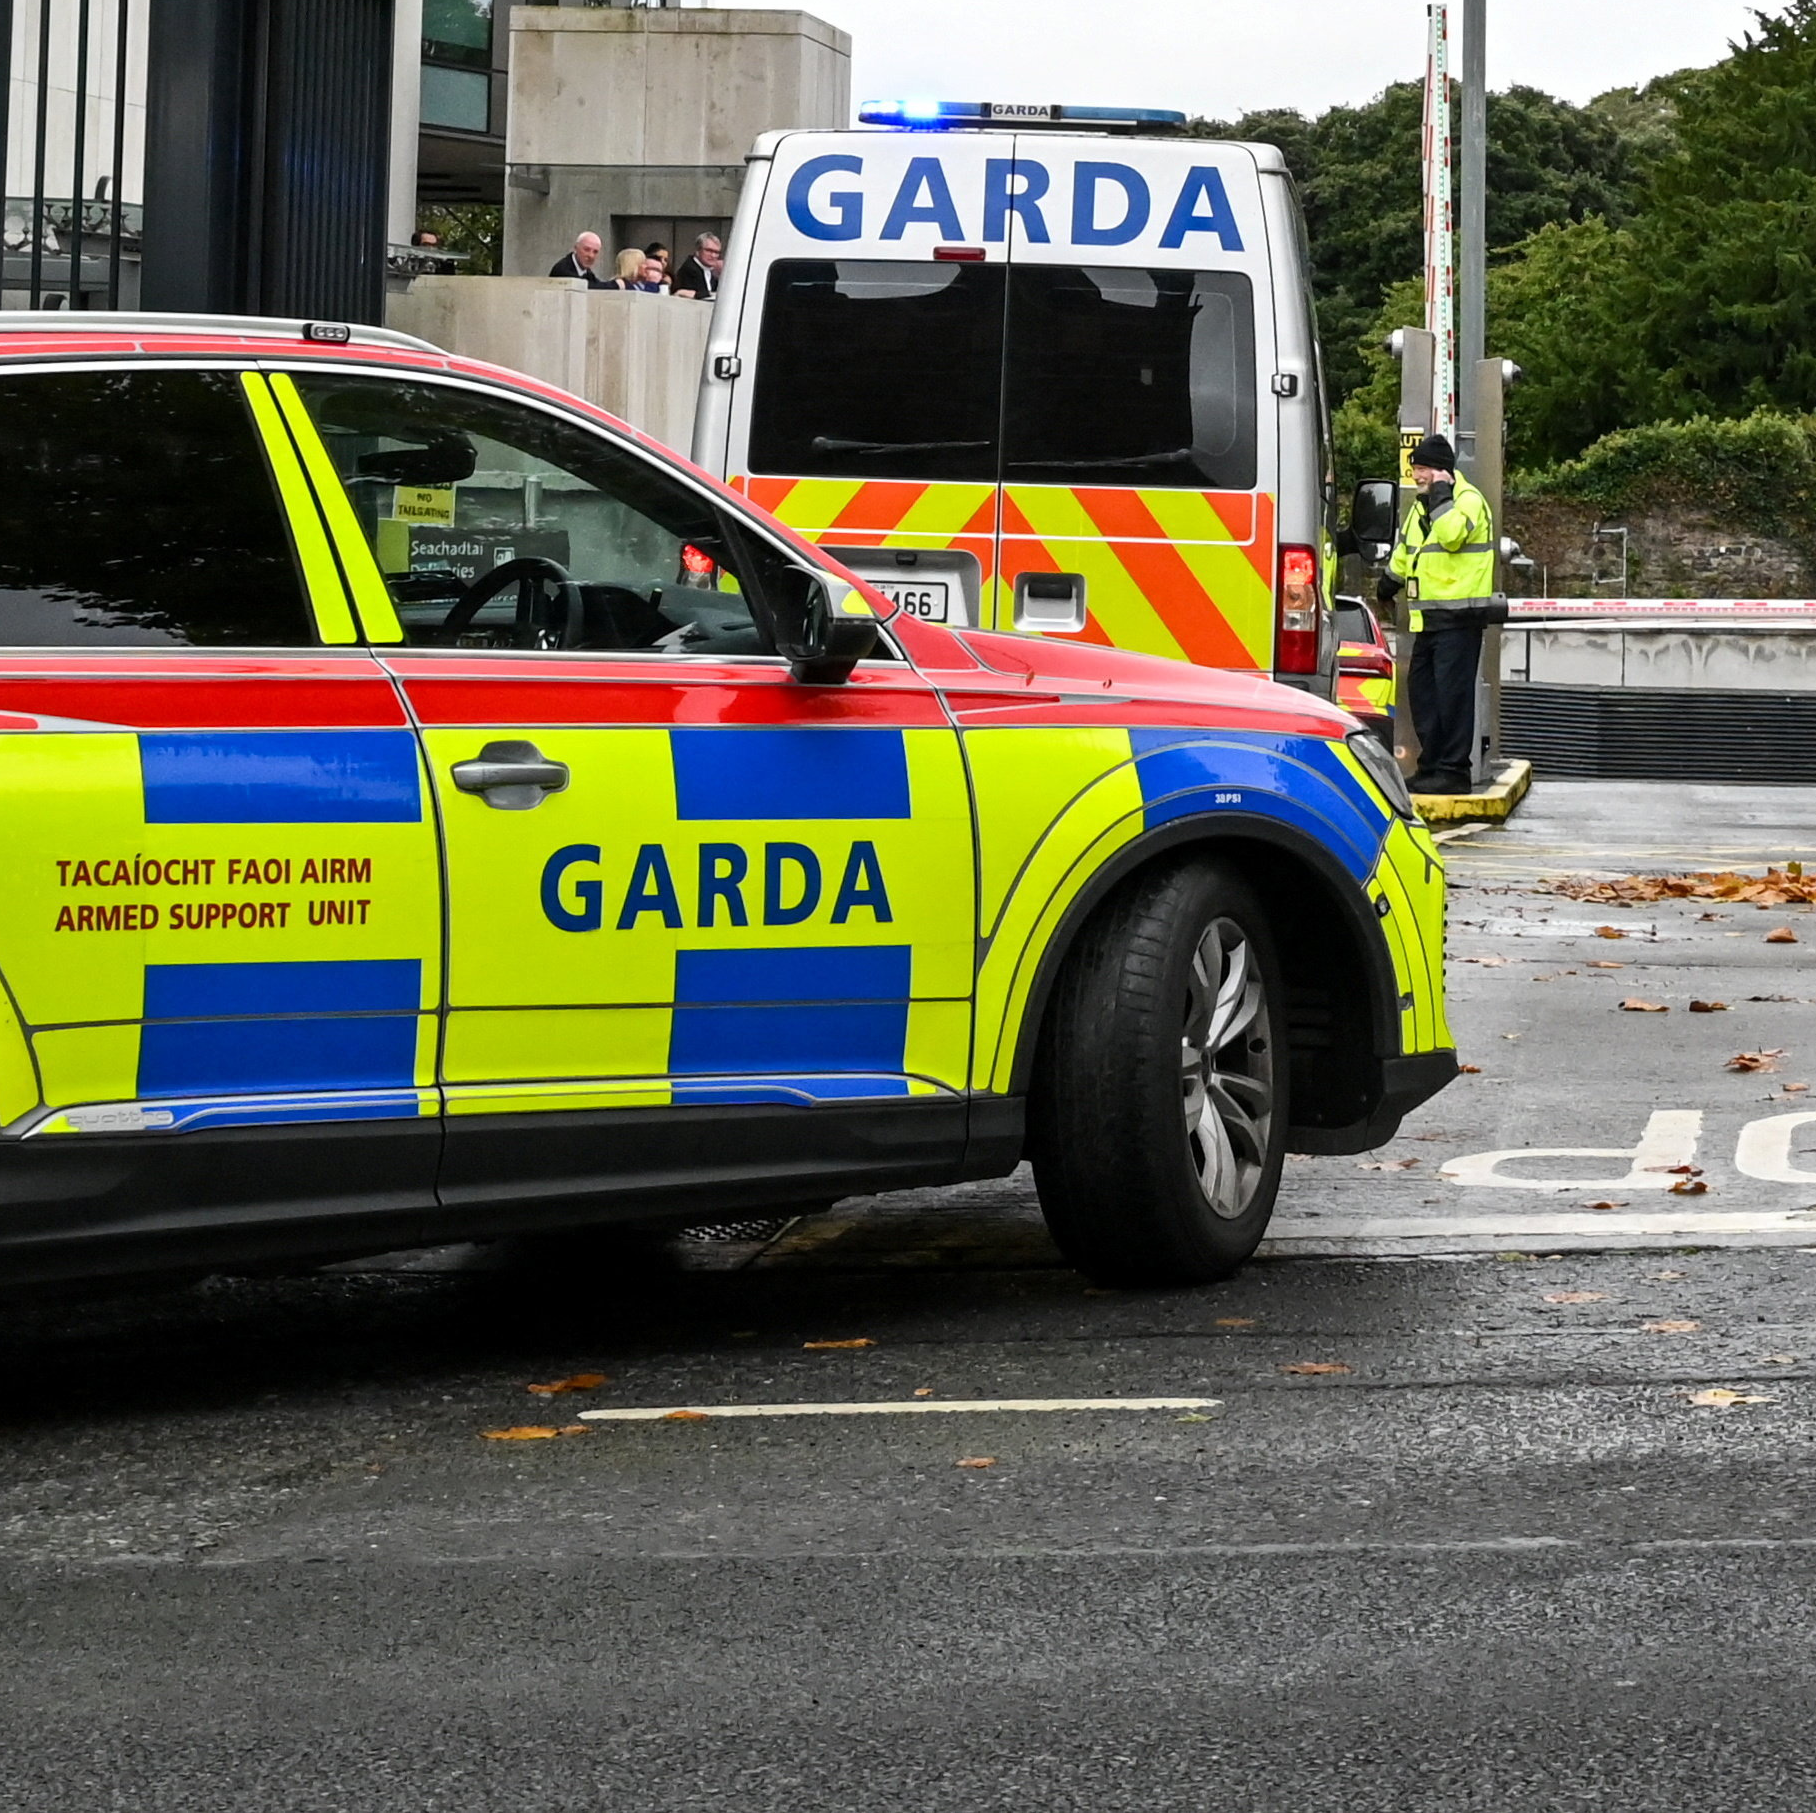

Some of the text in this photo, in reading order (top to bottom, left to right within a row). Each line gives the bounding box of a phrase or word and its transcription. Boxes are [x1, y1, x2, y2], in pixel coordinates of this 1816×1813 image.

[992, 104, 1049, 117] GARDA
[785, 154, 1245, 252] GARDA
[416, 493, 432, 503] NO
[56, 853, 371, 886] TACAÍOCHT FAOI AIRM
[540, 841, 894, 932] GARDA
[54, 899, 371, 932] ARMED SUPPORT UNIT
[67, 1110, 171, 1126] quattro
